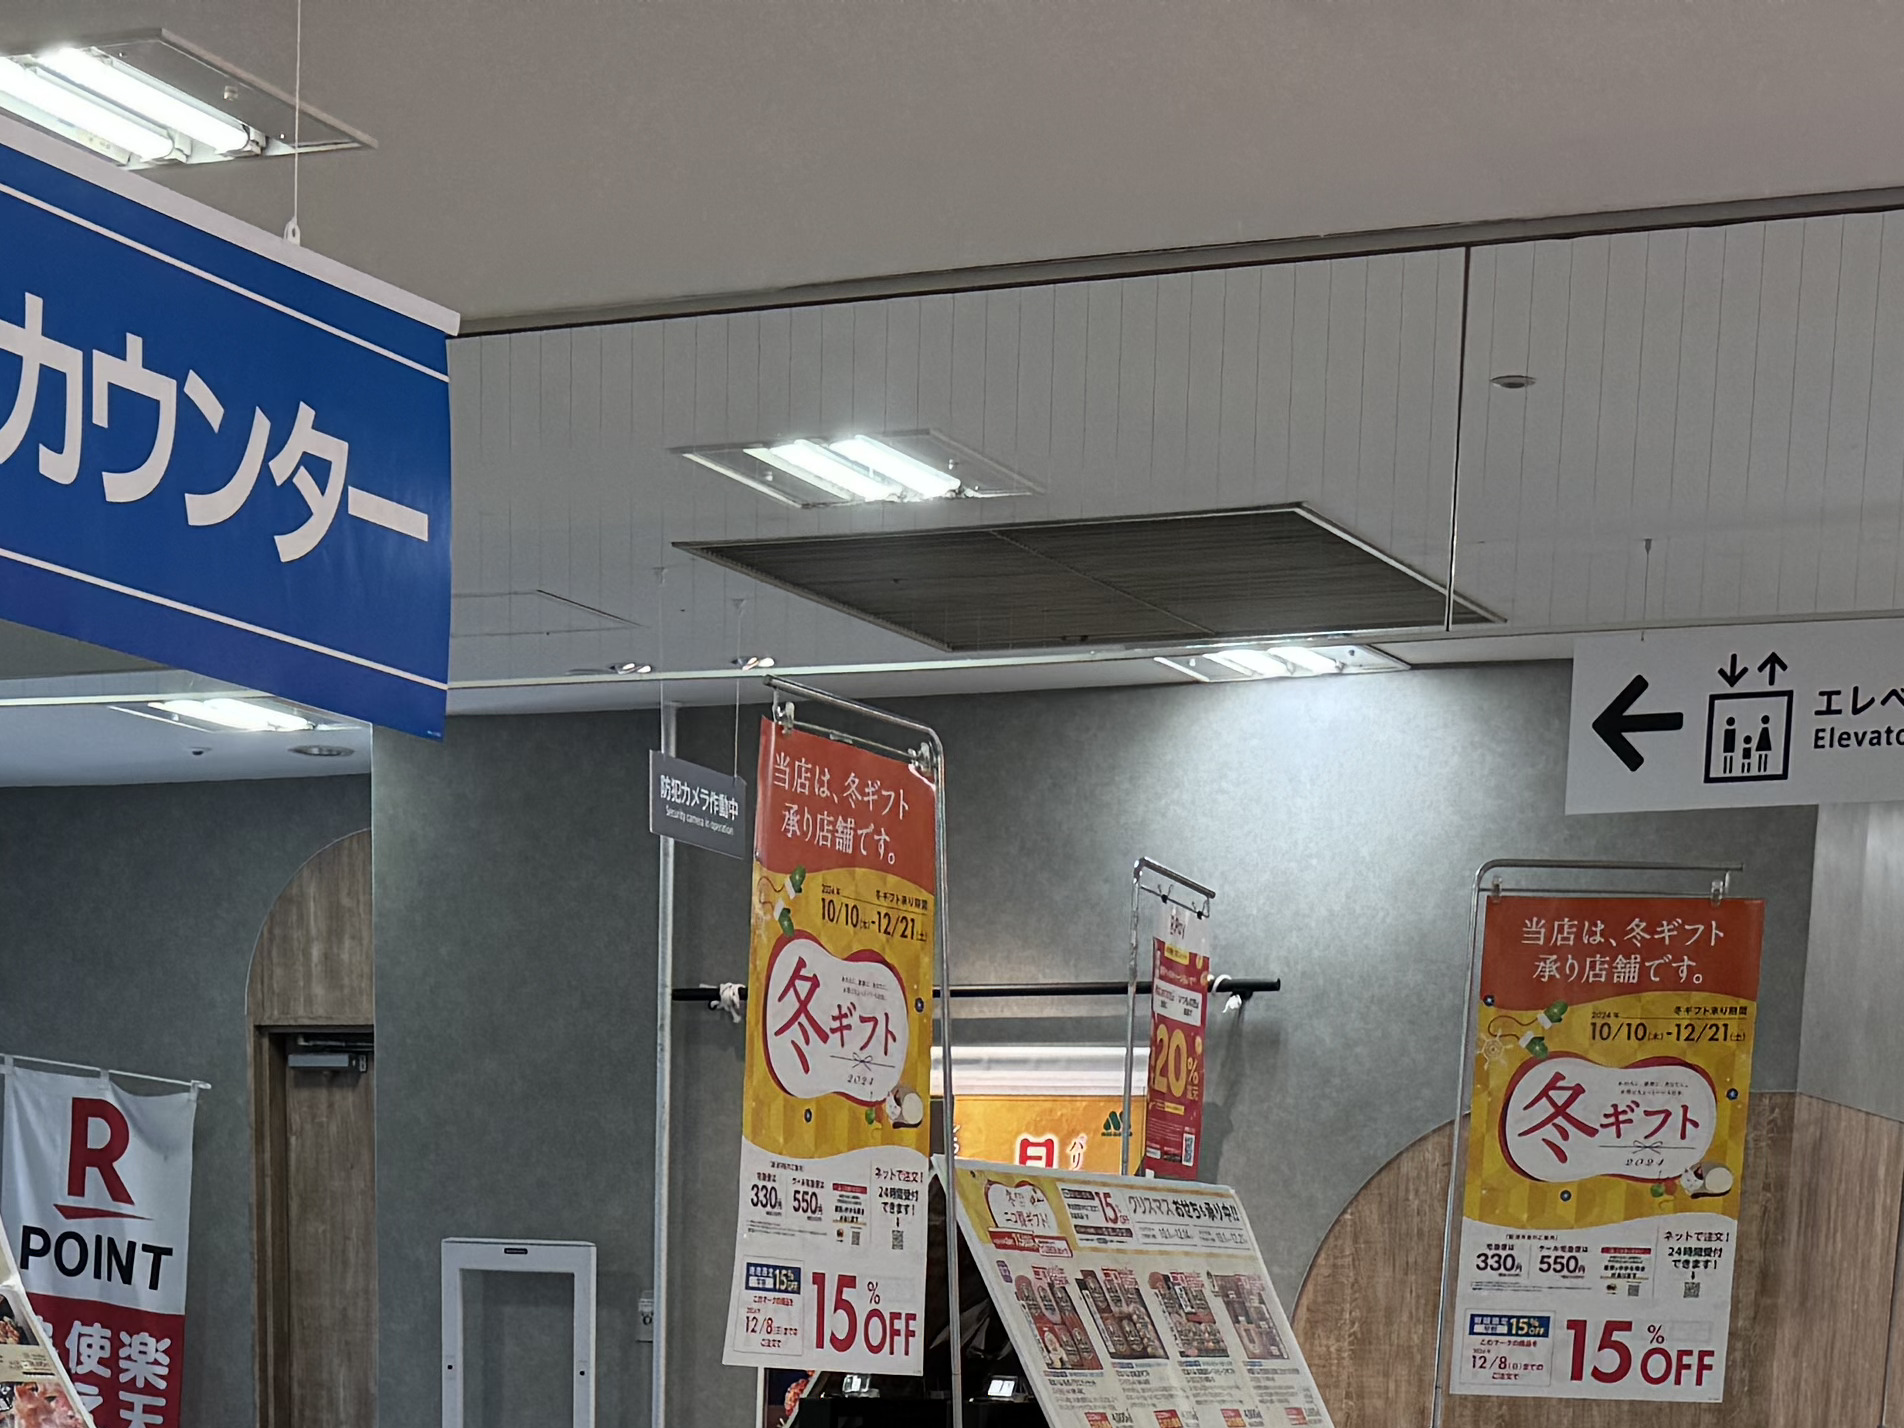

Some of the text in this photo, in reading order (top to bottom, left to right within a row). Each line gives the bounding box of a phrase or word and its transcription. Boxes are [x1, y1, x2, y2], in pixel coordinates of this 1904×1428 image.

[660, 774, 739, 821] 防犯カメラ作動中
[773, 752, 909, 820] 当店は、冬ギフト
[781, 803, 896, 864] 承り店舗です。
[1521, 917, 1724, 947] 当店は、冬ギフト
[1533, 954, 1703, 984] 承り店舗です。
[774, 956, 896, 1074] 冬ギフト
[1674, 1005, 1748, 1016] 冬ギフト承り期間
[847, 1074, 874, 1085] 2024
[1517, 1071, 1701, 1165] 冬ギフト
[67, 1096, 135, 1206] R
[19, 1224, 173, 1291] POINT
[1667, 1247, 1723, 1258] 24時間受付
[1672, 1258, 1717, 1270] できます!
